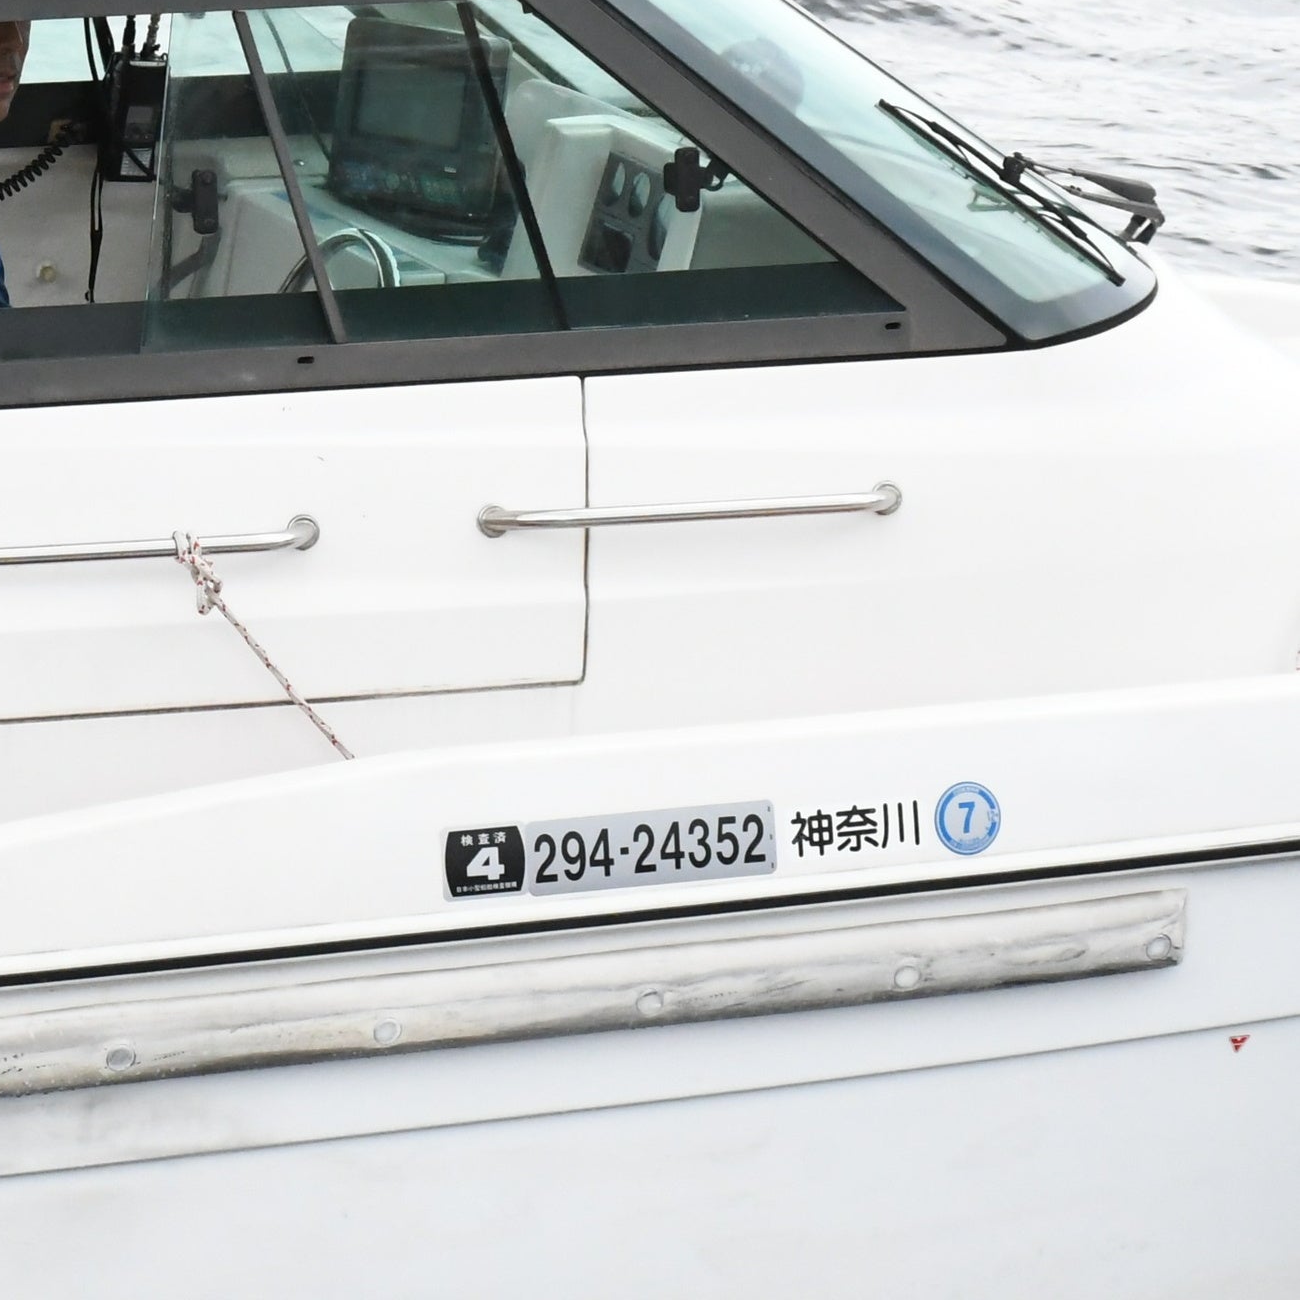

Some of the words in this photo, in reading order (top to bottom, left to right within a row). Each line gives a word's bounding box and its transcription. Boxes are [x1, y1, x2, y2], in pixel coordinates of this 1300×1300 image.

[790, 799, 921, 858] 神奈川
[958, 801, 976, 835] 7
[460, 831, 507, 847] 検査済
[533, 813, 767, 884] 294-24352
[466, 846, 505, 881] 4
